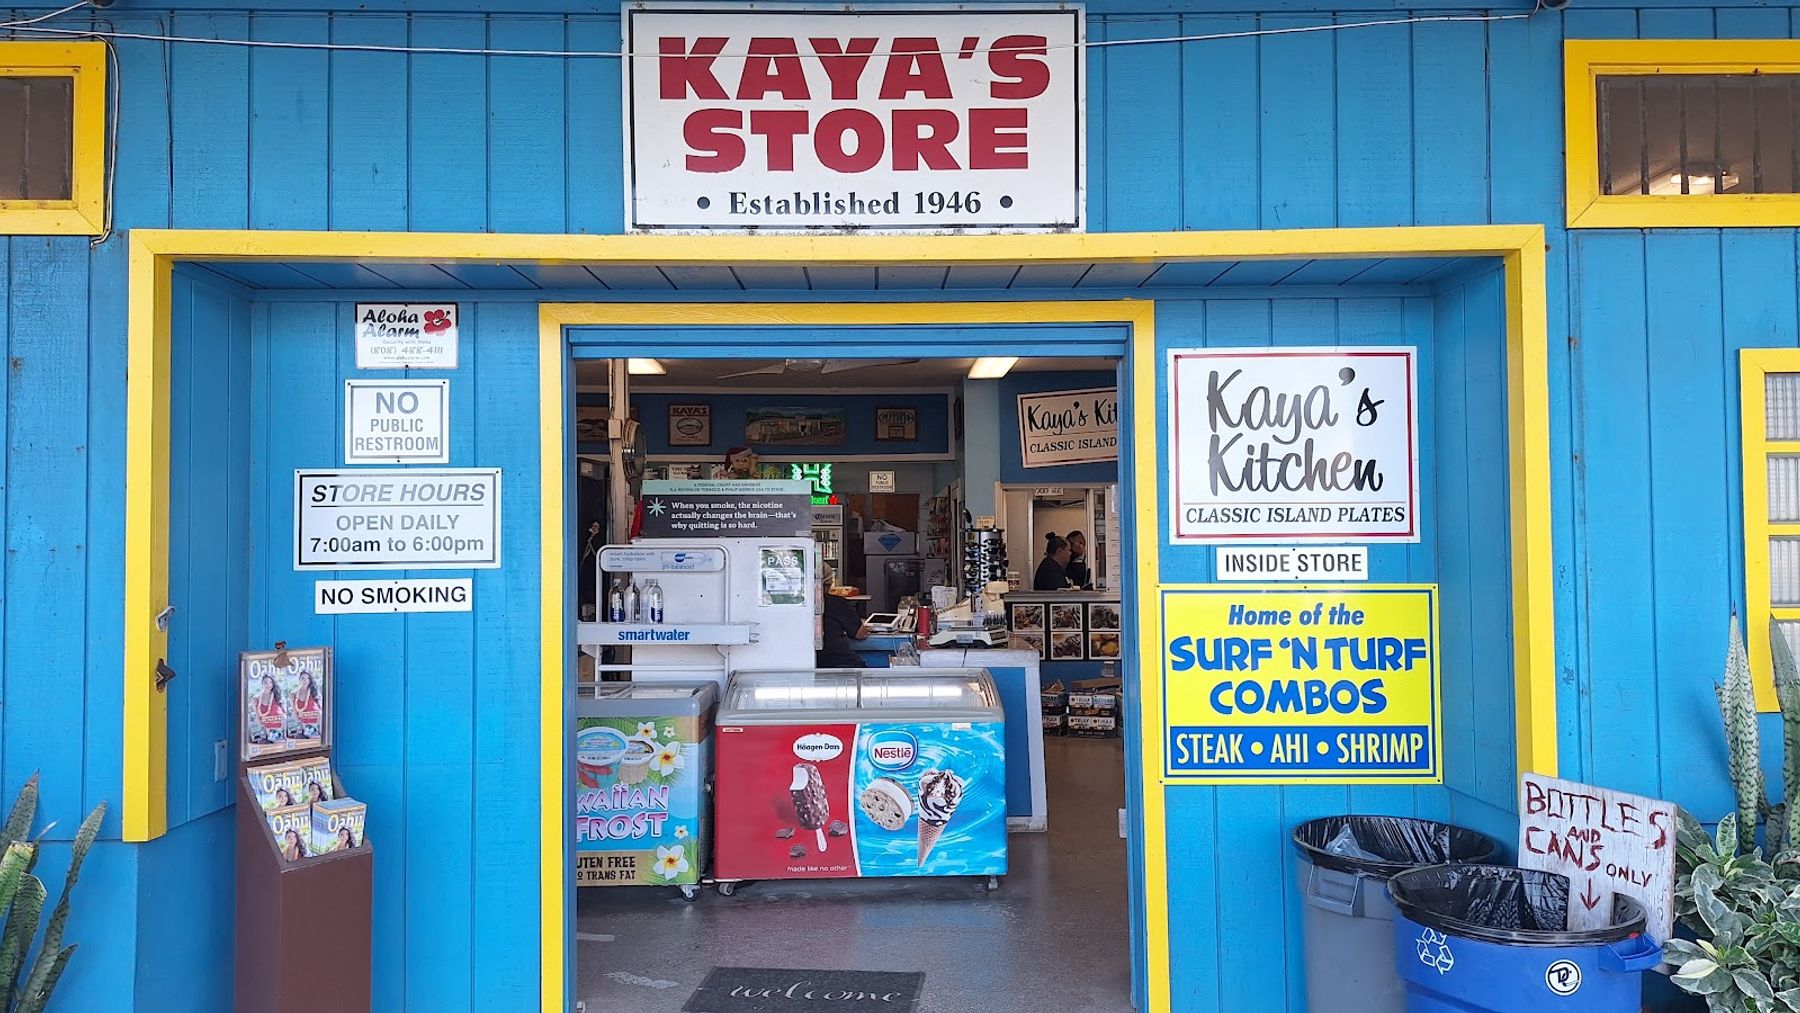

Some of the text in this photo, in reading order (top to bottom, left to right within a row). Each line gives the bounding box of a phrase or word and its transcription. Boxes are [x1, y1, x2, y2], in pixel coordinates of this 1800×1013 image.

[659, 35, 1050, 100] KAYA'S
[682, 108, 1029, 174] STORE
[728, 190, 982, 216] Established 1946
[362, 308, 419, 323] Aloha
[362, 323, 420, 338] Alarm
[370, 346, 397, 354] (808)
[376, 392, 419, 414] NO
[1206, 367, 1384, 445] Kaya's
[370, 418, 424, 432] PUBLIC
[1028, 401, 1088, 435] Kaya's
[355, 436, 438, 451] RESTROOM
[1030, 437, 1117, 453] CLASSIC ISLAND
[1208, 432, 1384, 496] Kitchen
[312, 483, 485, 502] STORE HOURS
[696, 503, 709, 511] you
[711, 502, 737, 510] smoke,
[1186, 507, 1406, 523] CLASSIC ISLAND PLATES
[336, 514, 460, 531] OPEN DAILY
[671, 512, 701, 520] actually
[703, 512, 733, 520] changes
[671, 522, 687, 530] why
[688, 522, 720, 530] quitting
[310, 536, 484, 554] 7:00am to 6:00pm
[768, 556, 798, 566] PASS
[1225, 554, 1362, 572] INSIDE STORE
[321, 586, 466, 605] NO SMOKING
[1228, 603, 1365, 626] Home of the
[618, 629, 690, 641] smartwater
[1169, 635, 1272, 672] SURF
[1324, 637, 1427, 672] TURF
[1210, 678, 1387, 715] COMBOS
[1176, 732, 1424, 764] STEAK AHI SHRIMP
[1526, 781, 1668, 850] BOTTLES
[576, 812, 668, 842] FROST
[1567, 826, 1601, 842] AND
[1525, 827, 1605, 872] CANS
[608, 857, 636, 868] FREE
[587, 870, 616, 880] TRANS
[620, 870, 636, 879] FAT
[1606, 863, 1652, 888] ONLY
[730, 980, 901, 1002] welcome
